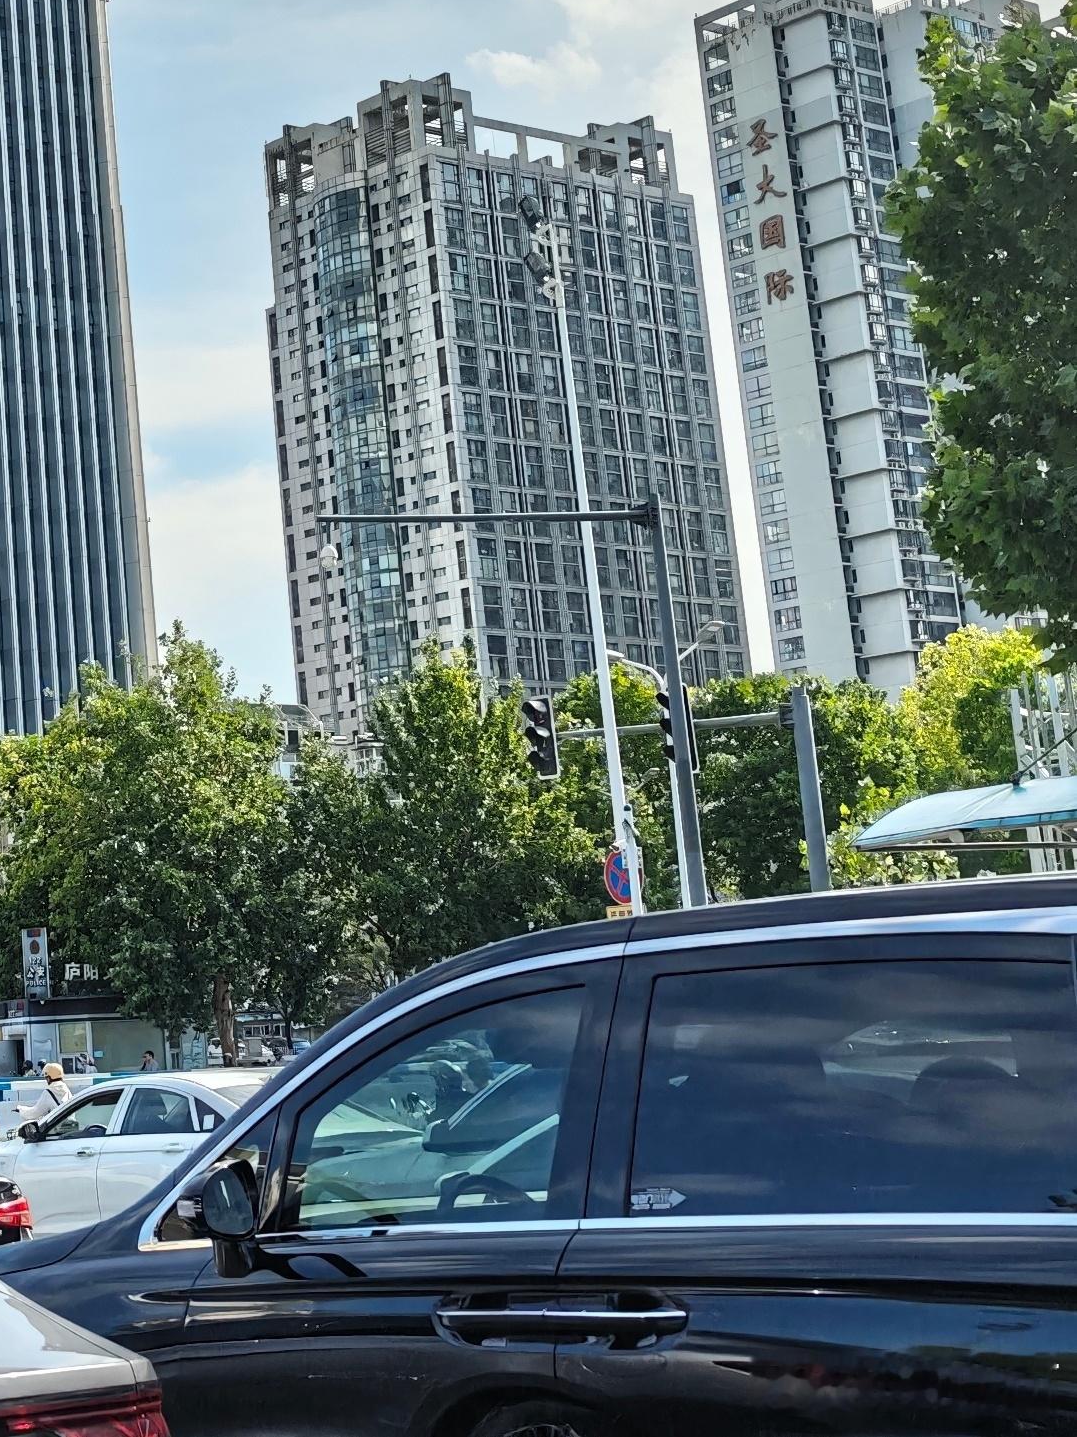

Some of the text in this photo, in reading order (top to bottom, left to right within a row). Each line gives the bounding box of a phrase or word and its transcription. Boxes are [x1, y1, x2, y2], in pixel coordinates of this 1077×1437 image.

[28, 956, 42, 965] 122
[26, 966, 45, 978] 公安
[64, 962, 111, 981] 庐阳
